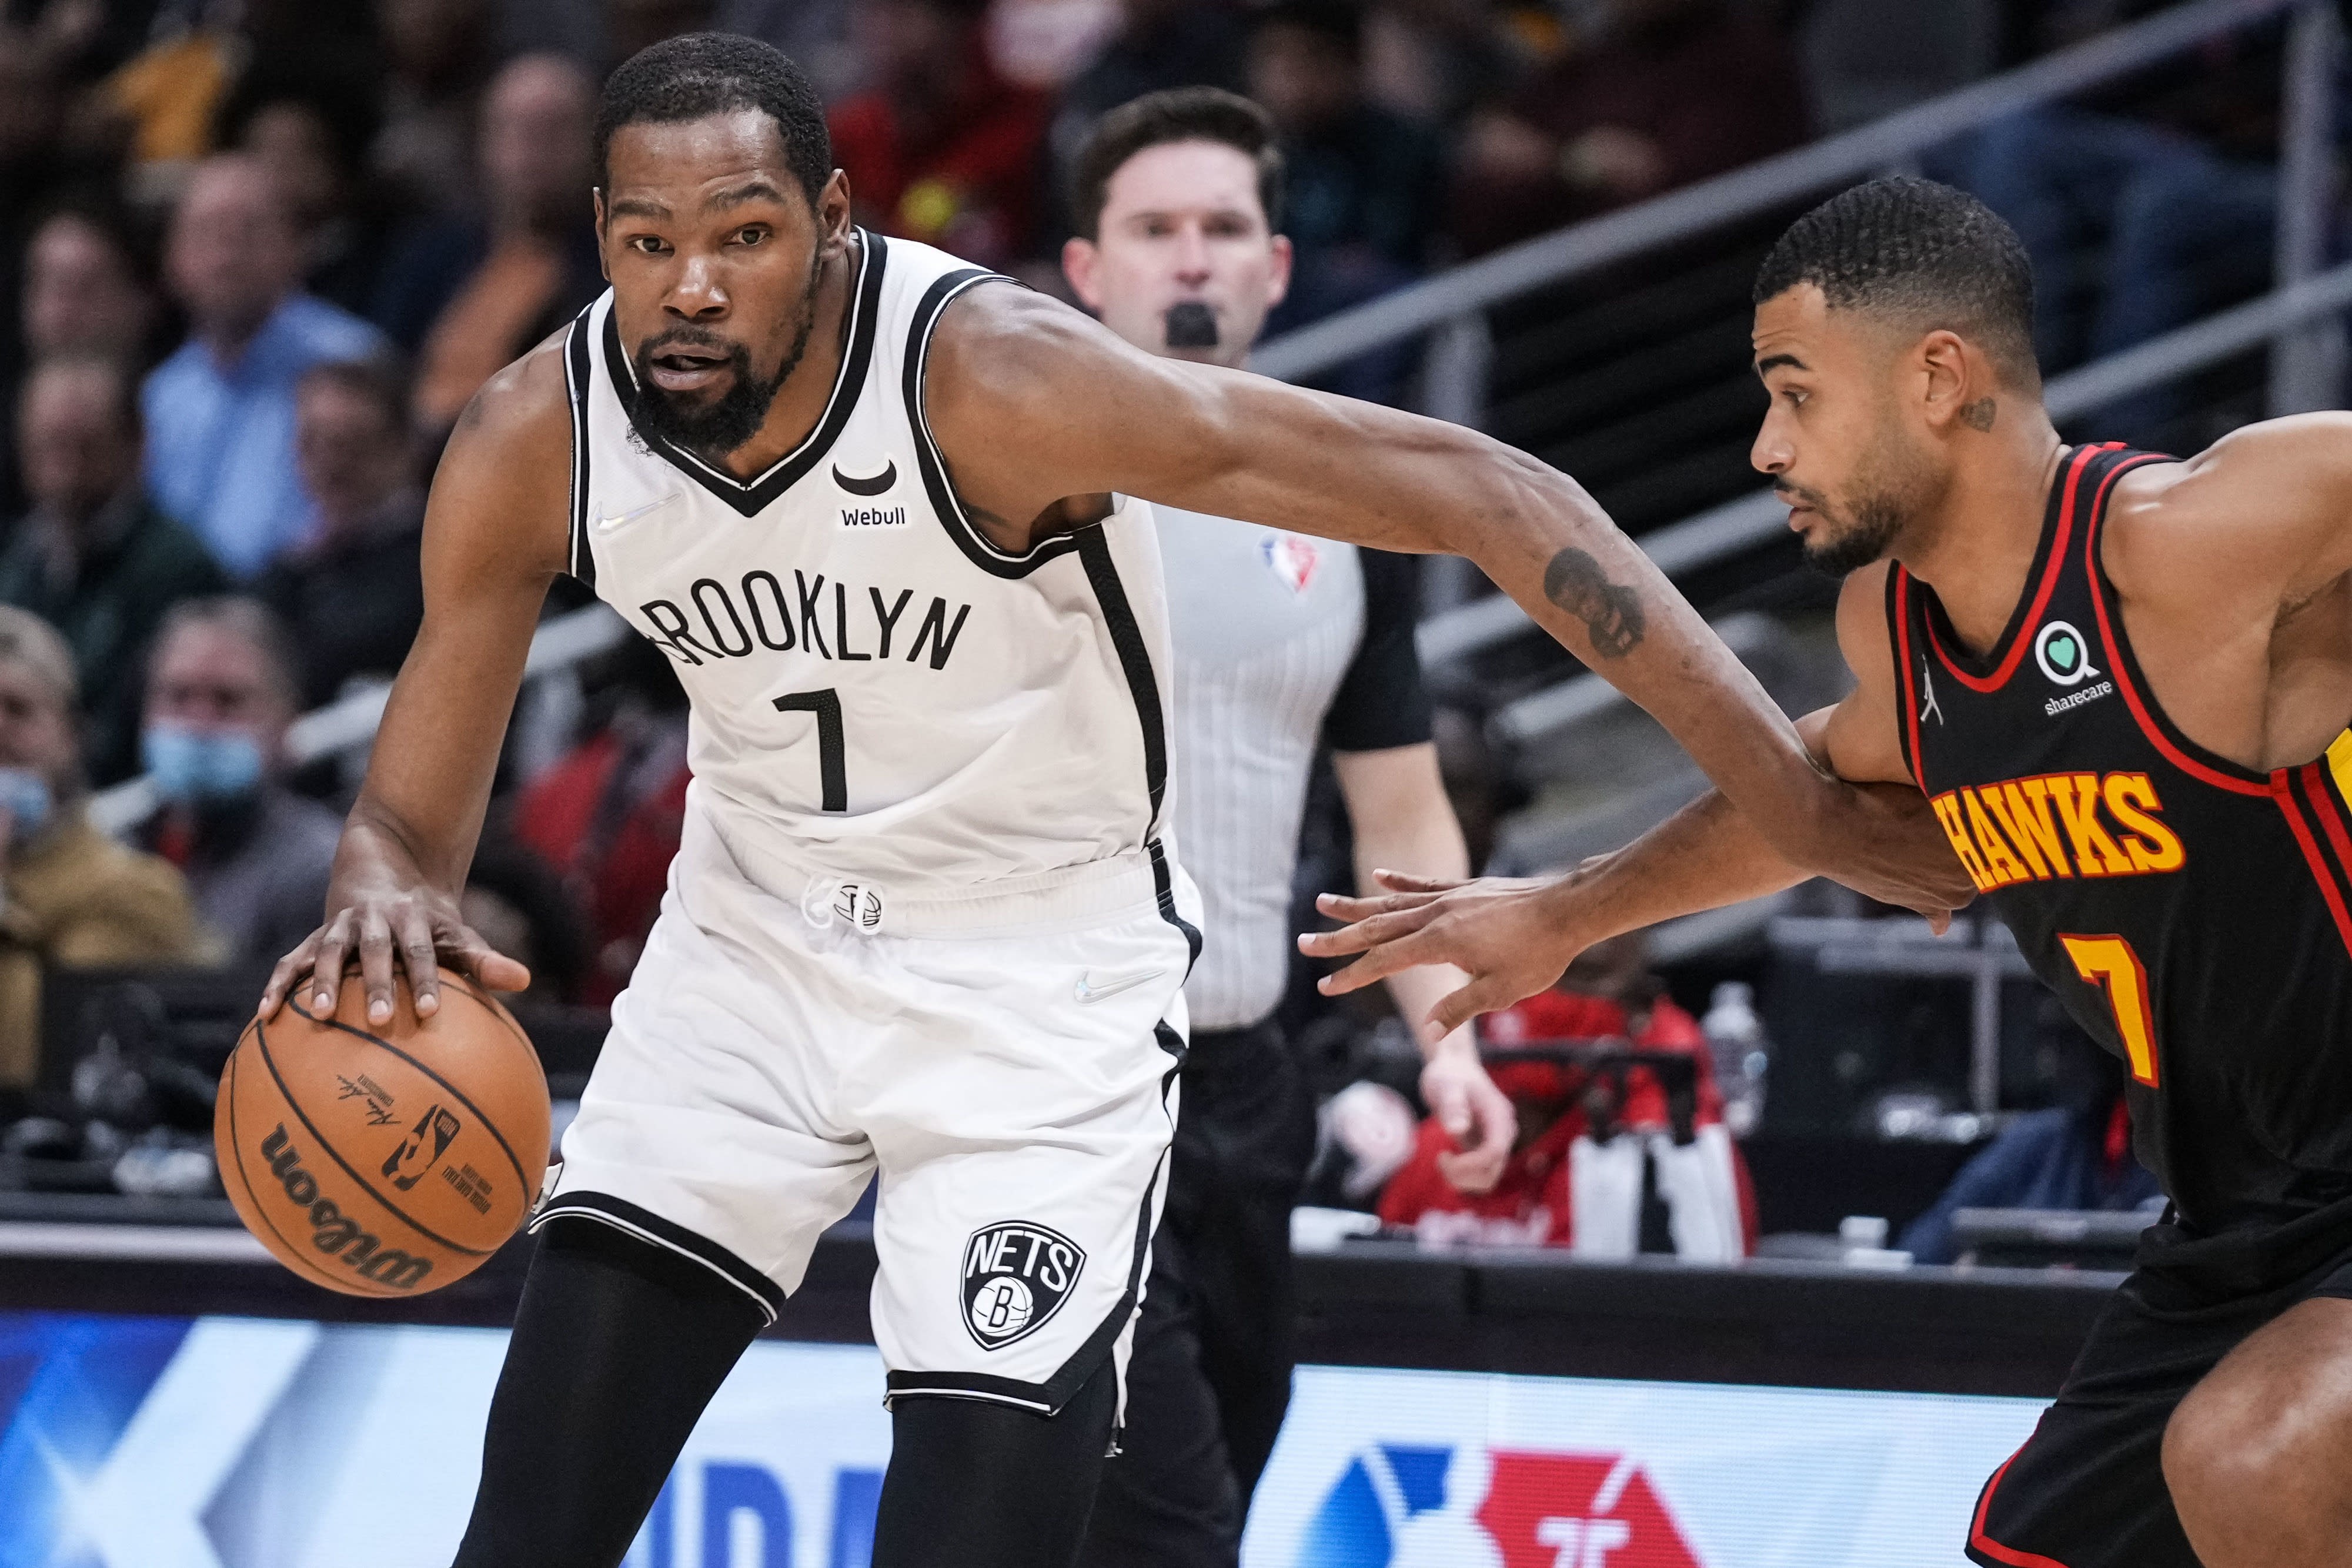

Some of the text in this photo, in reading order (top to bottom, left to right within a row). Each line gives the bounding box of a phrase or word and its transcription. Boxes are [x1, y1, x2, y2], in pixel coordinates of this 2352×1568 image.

[841, 507, 905, 526] Webull
[2044, 680, 2113, 717] sharecare
[771, 687, 847, 813] 7
[1929, 771, 2186, 894] HAWKS
[2057, 932, 2159, 1088] 7
[260, 1122, 433, 1289] Wilson
[965, 1229, 1074, 1292] NETS
[988, 1285, 1014, 1328] B
